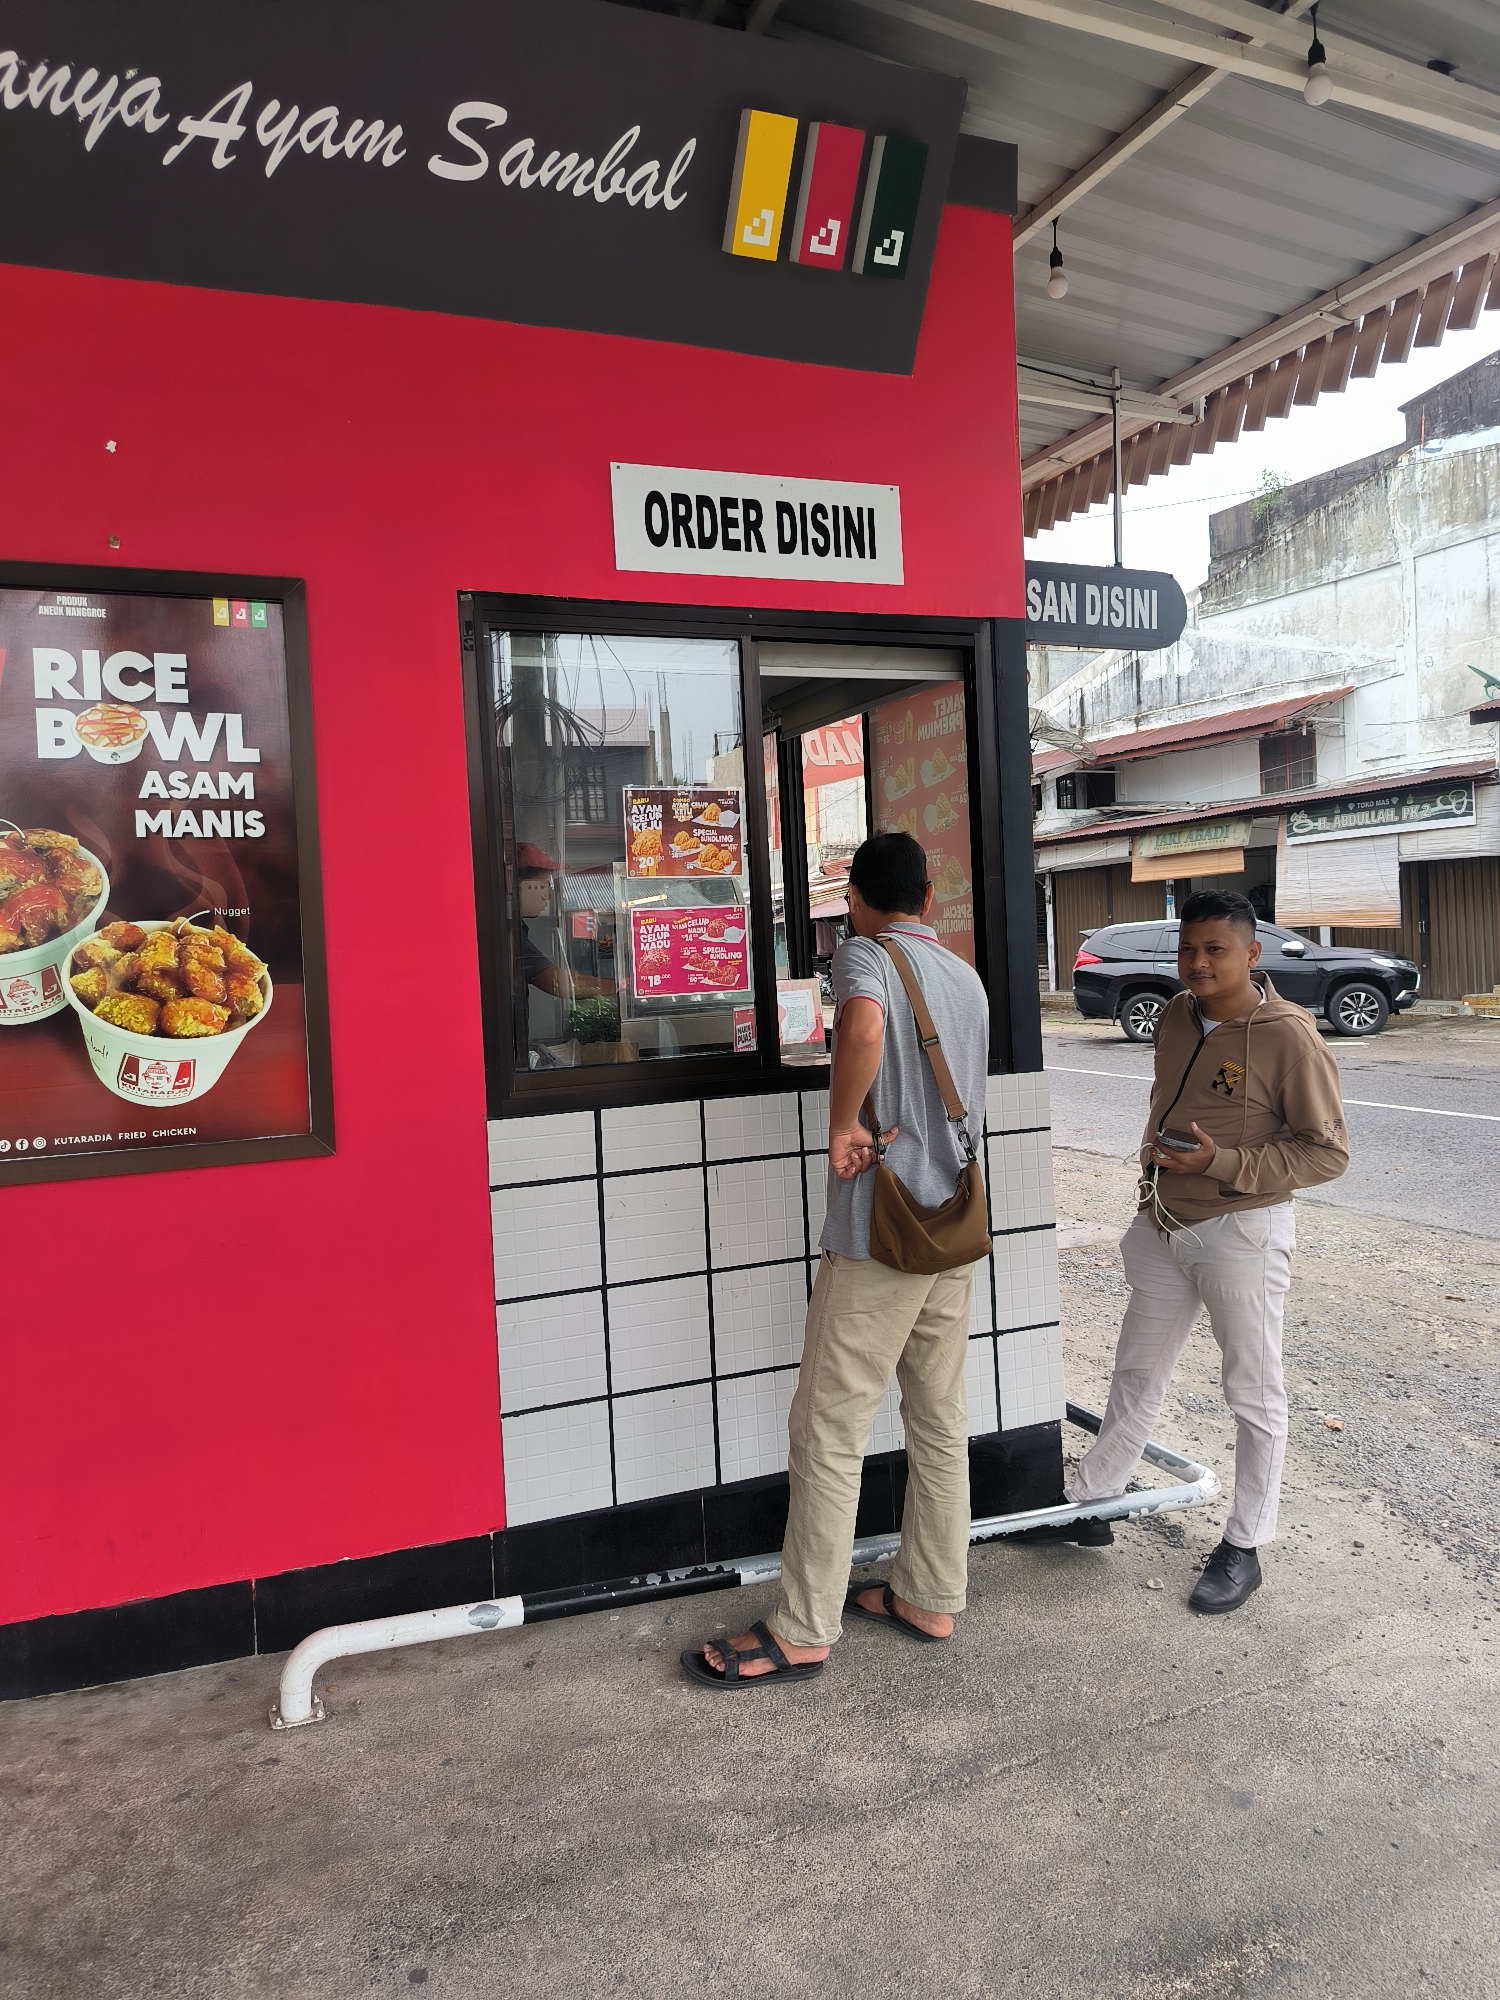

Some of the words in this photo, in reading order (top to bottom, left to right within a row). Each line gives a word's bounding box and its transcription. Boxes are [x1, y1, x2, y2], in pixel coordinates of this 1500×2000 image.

[162, 81, 406, 177] Ayam
[427, 101, 696, 211] Sambal
[645, 490, 767, 553] ORDER
[775, 500, 877, 560] DISINI
[57, 595, 88, 607] PRODUK
[1026, 578, 1077, 624] SAN
[1085, 583, 1158, 630] DISINI
[39, 605, 64, 616] ANEUK
[65, 606, 107, 619] NANGGROE
[32, 647, 190, 703] RICE
[138, 770, 255, 800] ASAM
[631, 804, 663, 814] AYAM
[1357, 800, 1375, 809] TOKO
[1375, 799, 1390, 808] MAS
[135, 809, 266, 838] MANIS
[632, 813, 663, 823] CELUP
[632, 820, 663, 832] KEJU
[692, 828, 718, 837] SPECIAL
[1154, 830, 1183, 849] JARI
[1184, 824, 1231, 844] ABADI
[700, 835, 735, 843] BUNDLING
[213, 907, 251, 917] Nugget
[640, 917, 657, 925] BARU
[687, 917, 710, 928] CELUP
[639, 924, 670, 934] AYAM
[640, 933, 670, 943] CELUP
[640, 941, 671, 951] MADU
[702, 946, 727, 955] SPECIAL
[54, 1133, 113, 1145] KUTARADJA
[118, 1131, 147, 1140] FRIED
[152, 1127, 197, 1138] CHICKEN
